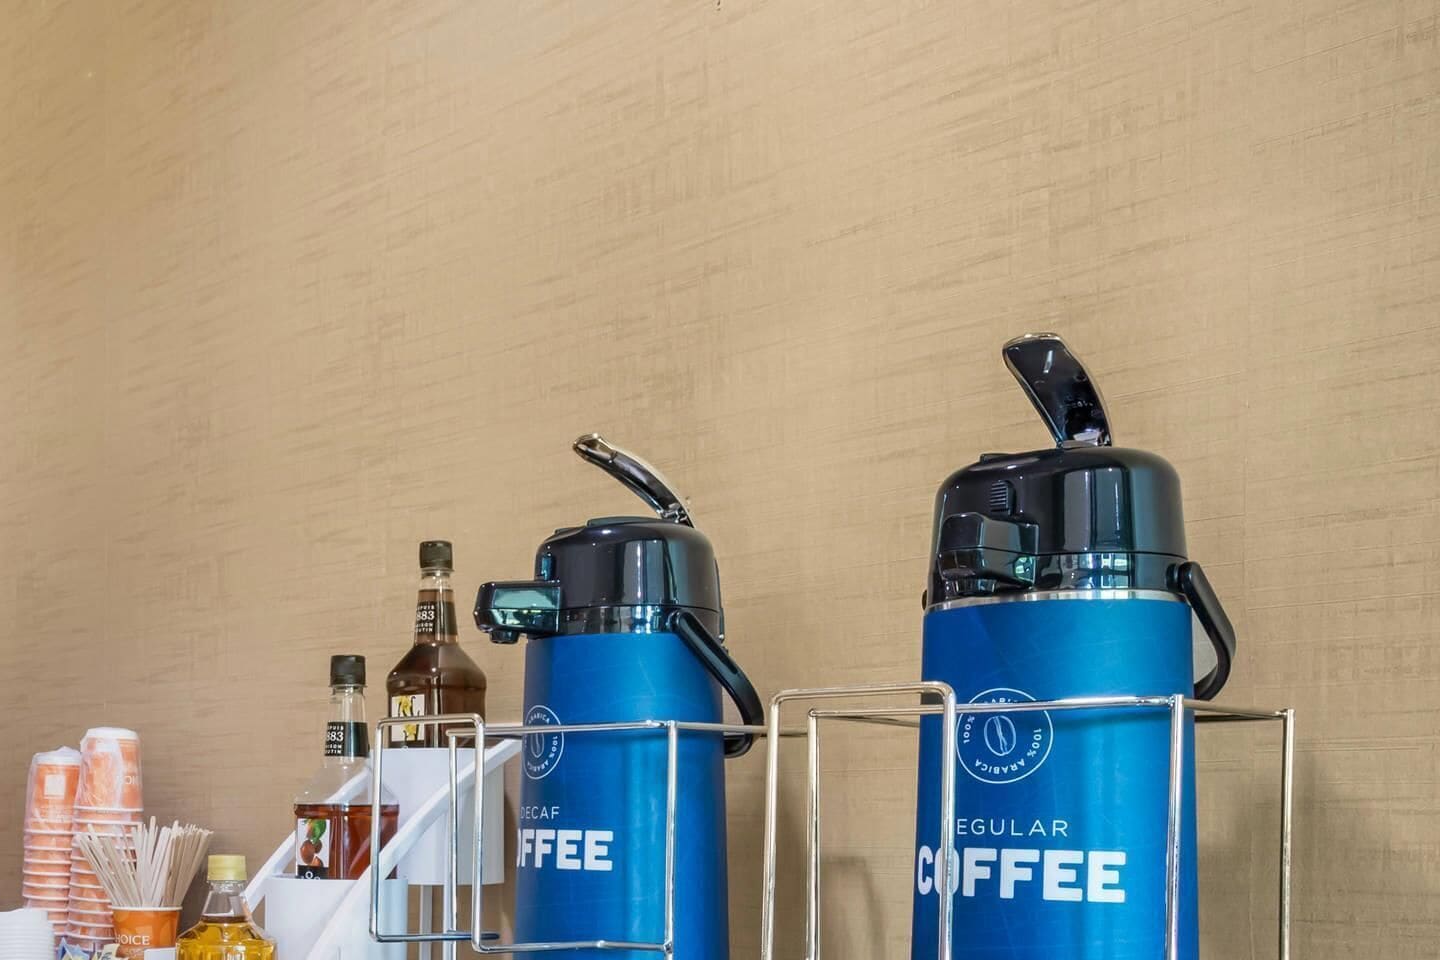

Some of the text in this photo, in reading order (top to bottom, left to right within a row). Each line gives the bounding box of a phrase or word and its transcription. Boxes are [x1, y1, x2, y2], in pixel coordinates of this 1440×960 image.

[548, 735, 558, 758] 100%
[975, 728, 1042, 775] 100% ARABICA
[520, 806, 560, 820] DECAF
[956, 817, 1068, 837] EGULAR
[917, 844, 1127, 904] COFFEE
